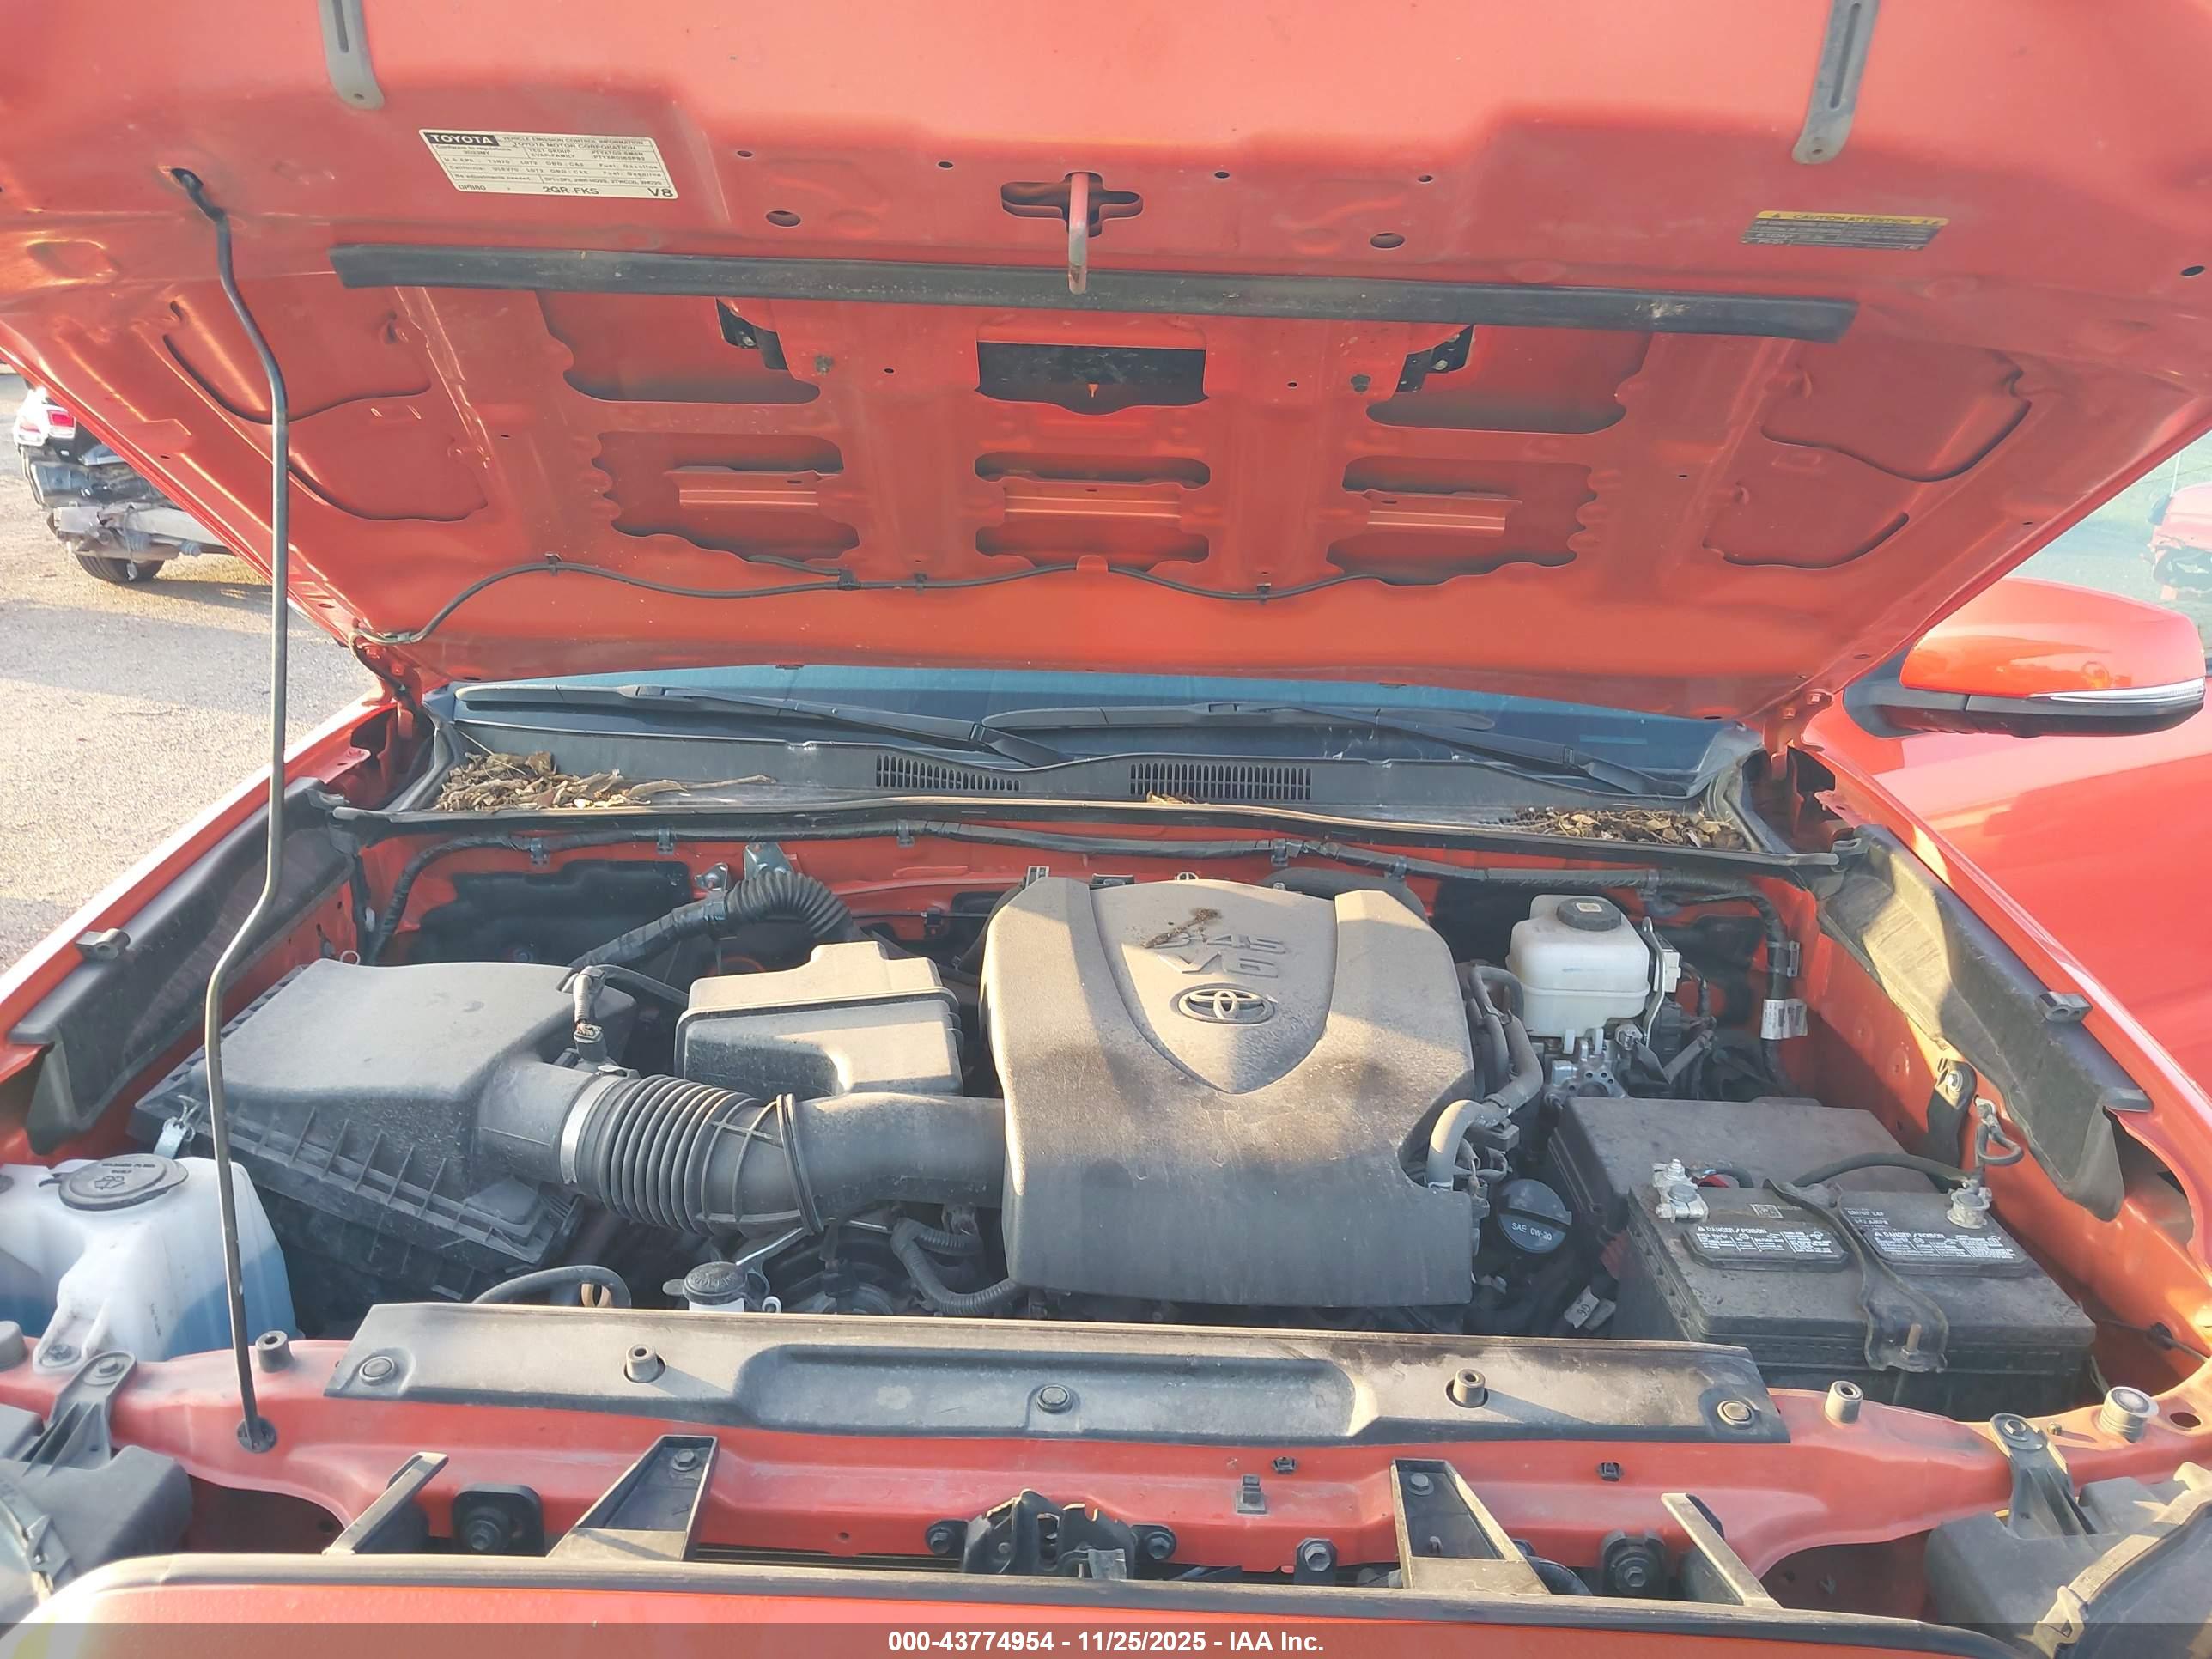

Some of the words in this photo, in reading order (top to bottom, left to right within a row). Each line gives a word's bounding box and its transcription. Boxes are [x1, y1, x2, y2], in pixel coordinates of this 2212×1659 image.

[429, 134, 494, 145] TOYOTA
[542, 185, 600, 196] 2GR-FKS
[1157, 951, 1279, 979] V6
[1511, 1222, 1528, 1234] SAE
[1530, 1226, 1553, 1242] 0W-20
